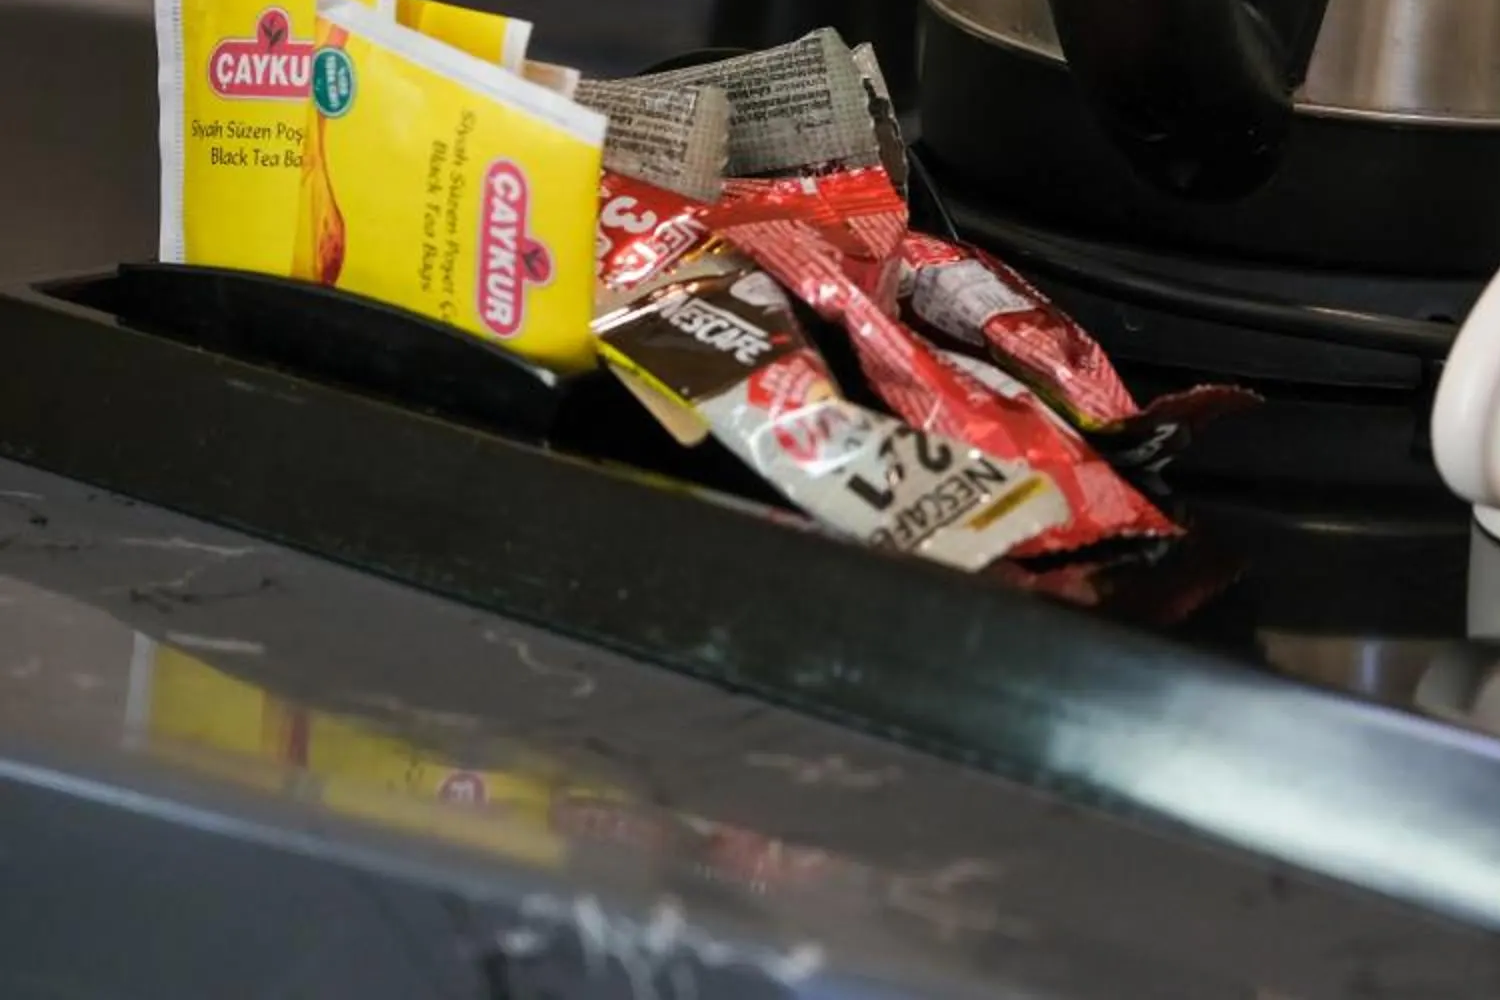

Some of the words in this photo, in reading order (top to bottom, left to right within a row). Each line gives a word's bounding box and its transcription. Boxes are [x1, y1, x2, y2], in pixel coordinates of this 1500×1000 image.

[215, 52, 312, 92] ÇAYKU
[191, 119, 223, 141] Siyah
[226, 119, 272, 140] Süzen
[275, 120, 304, 146] Poş
[210, 146, 248, 167] Black
[252, 147, 281, 167] Tea
[283, 149, 304, 168] Ba
